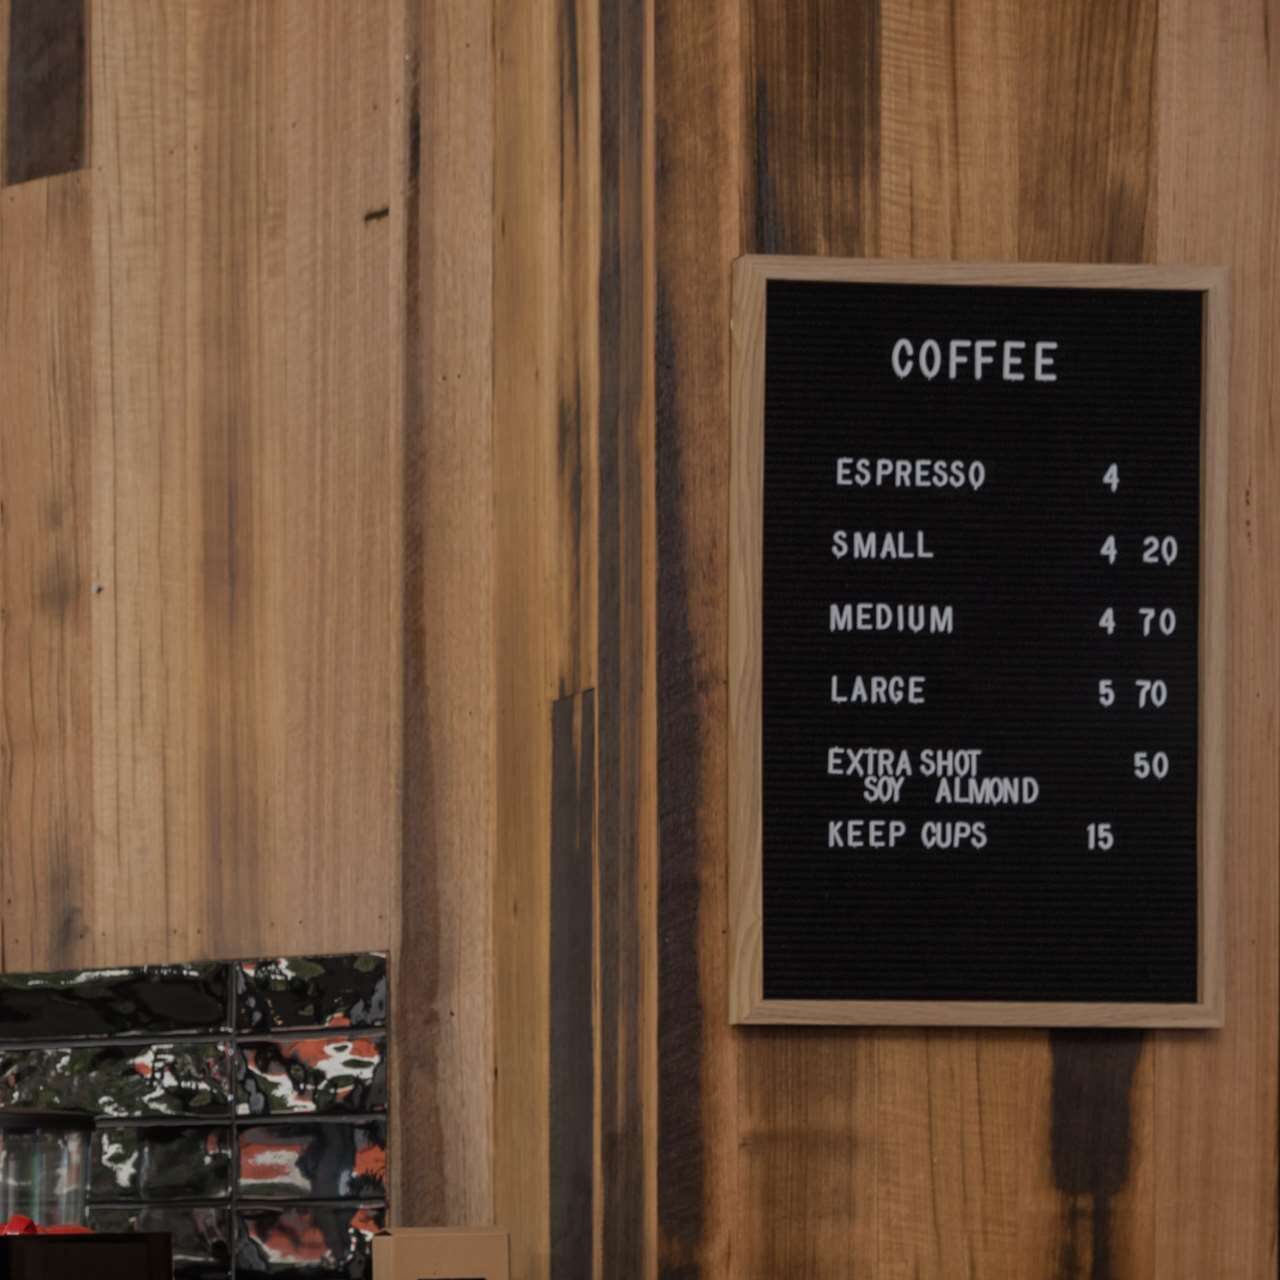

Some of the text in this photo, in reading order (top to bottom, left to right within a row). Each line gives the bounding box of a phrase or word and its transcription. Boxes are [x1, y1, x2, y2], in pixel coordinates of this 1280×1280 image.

[891, 337, 1059, 383] COFFEE
[836, 457, 1120, 493] ESPRESSO 4
[831, 530, 1179, 567] SMALL 4 20
[829, 603, 1177, 637] MEDIUM 4 70
[830, 675, 1168, 709] LARGE 5 70
[827, 746, 1169, 780] EXTRA SHOT 50
[864, 775, 1039, 805] SOY ALMOND
[827, 820, 1115, 851] KEEP CUPS 15
